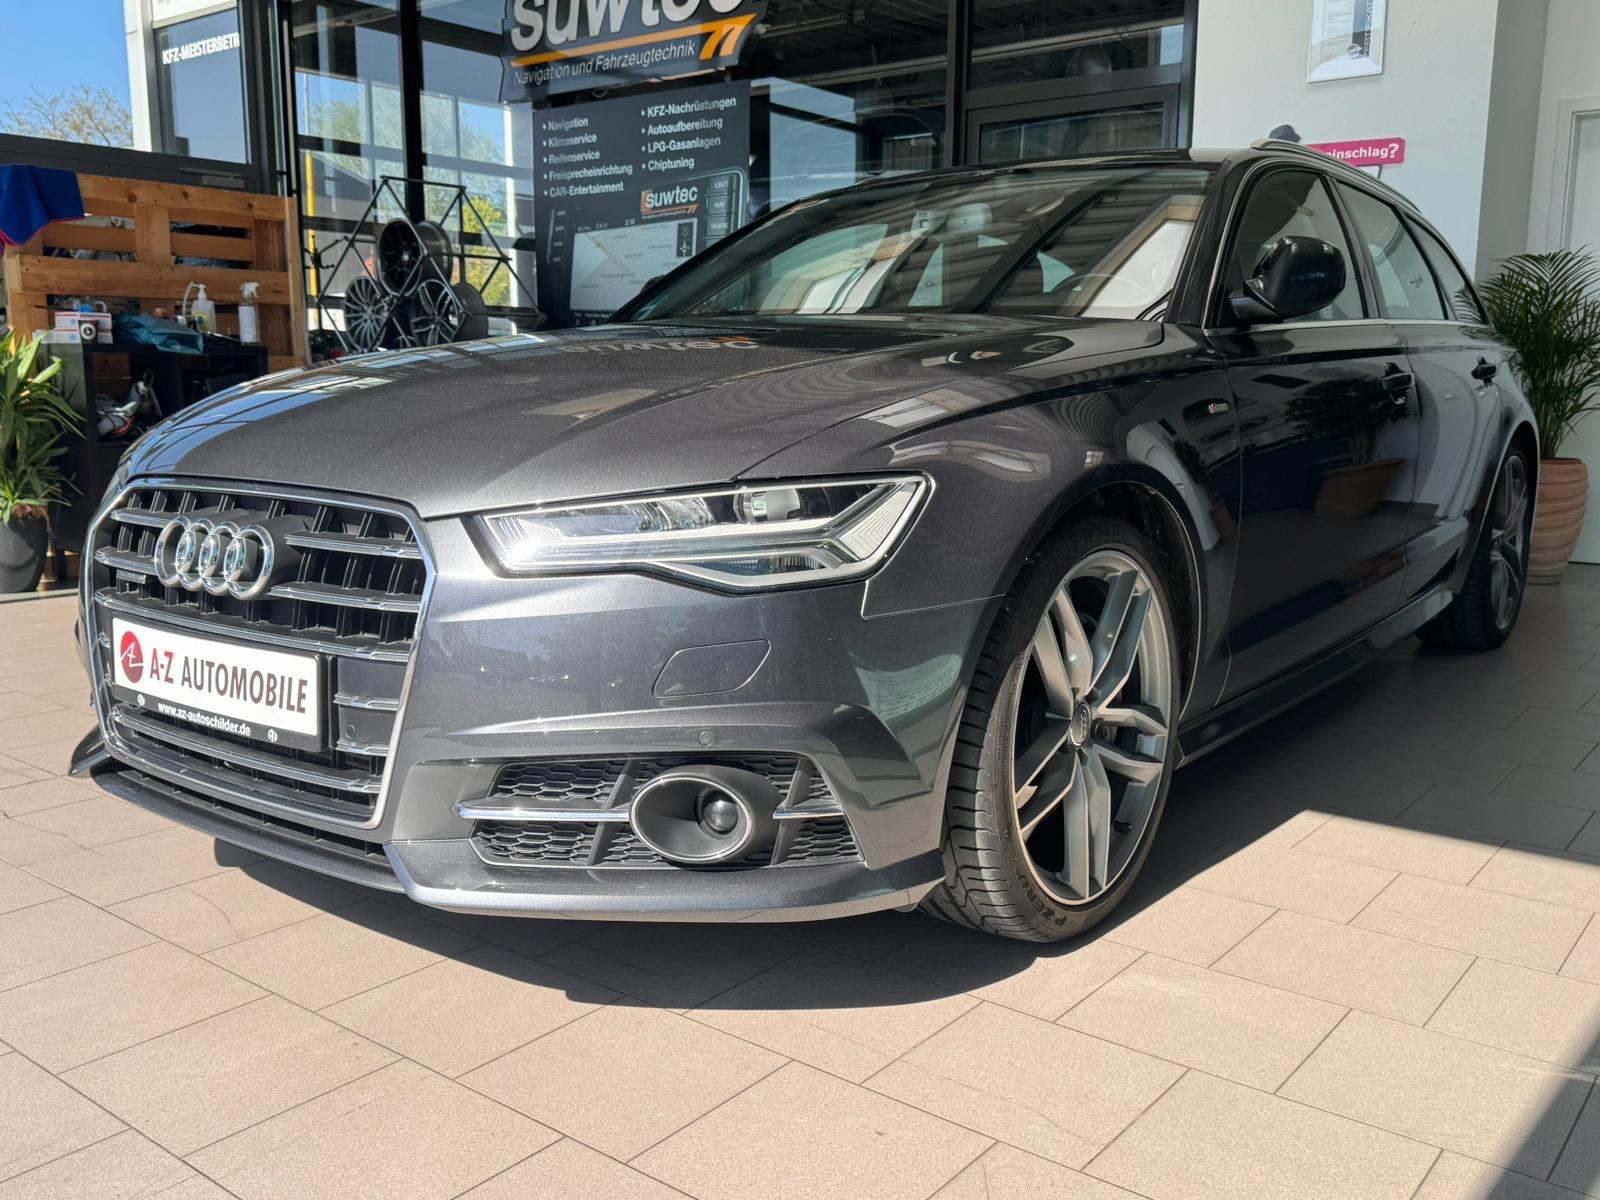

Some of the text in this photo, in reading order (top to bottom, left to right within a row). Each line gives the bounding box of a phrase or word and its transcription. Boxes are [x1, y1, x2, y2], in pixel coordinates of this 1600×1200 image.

[514, 41, 695, 86] Navigation und Fahrzeugtechnik
[647, 97, 736, 118] KFZ-Nachrüstungen
[548, 117, 588, 131] Navigation
[647, 118, 723, 136] Autoaufbereitung
[548, 133, 598, 148] Klimaservice
[647, 137, 721, 153] LPG-Gasanlagen
[548, 149, 600, 164] Reifenservice
[647, 156, 695, 172] Chiptuning
[548, 165, 633, 181] Freisprecheinrichtung
[549, 181, 624, 197] CAR-Entertainment
[645, 185, 698, 208] suwtec
[150, 647, 308, 714] A-Z AUTOMOBILE
[158, 702, 251, 736] www.az-autoschilder.de
